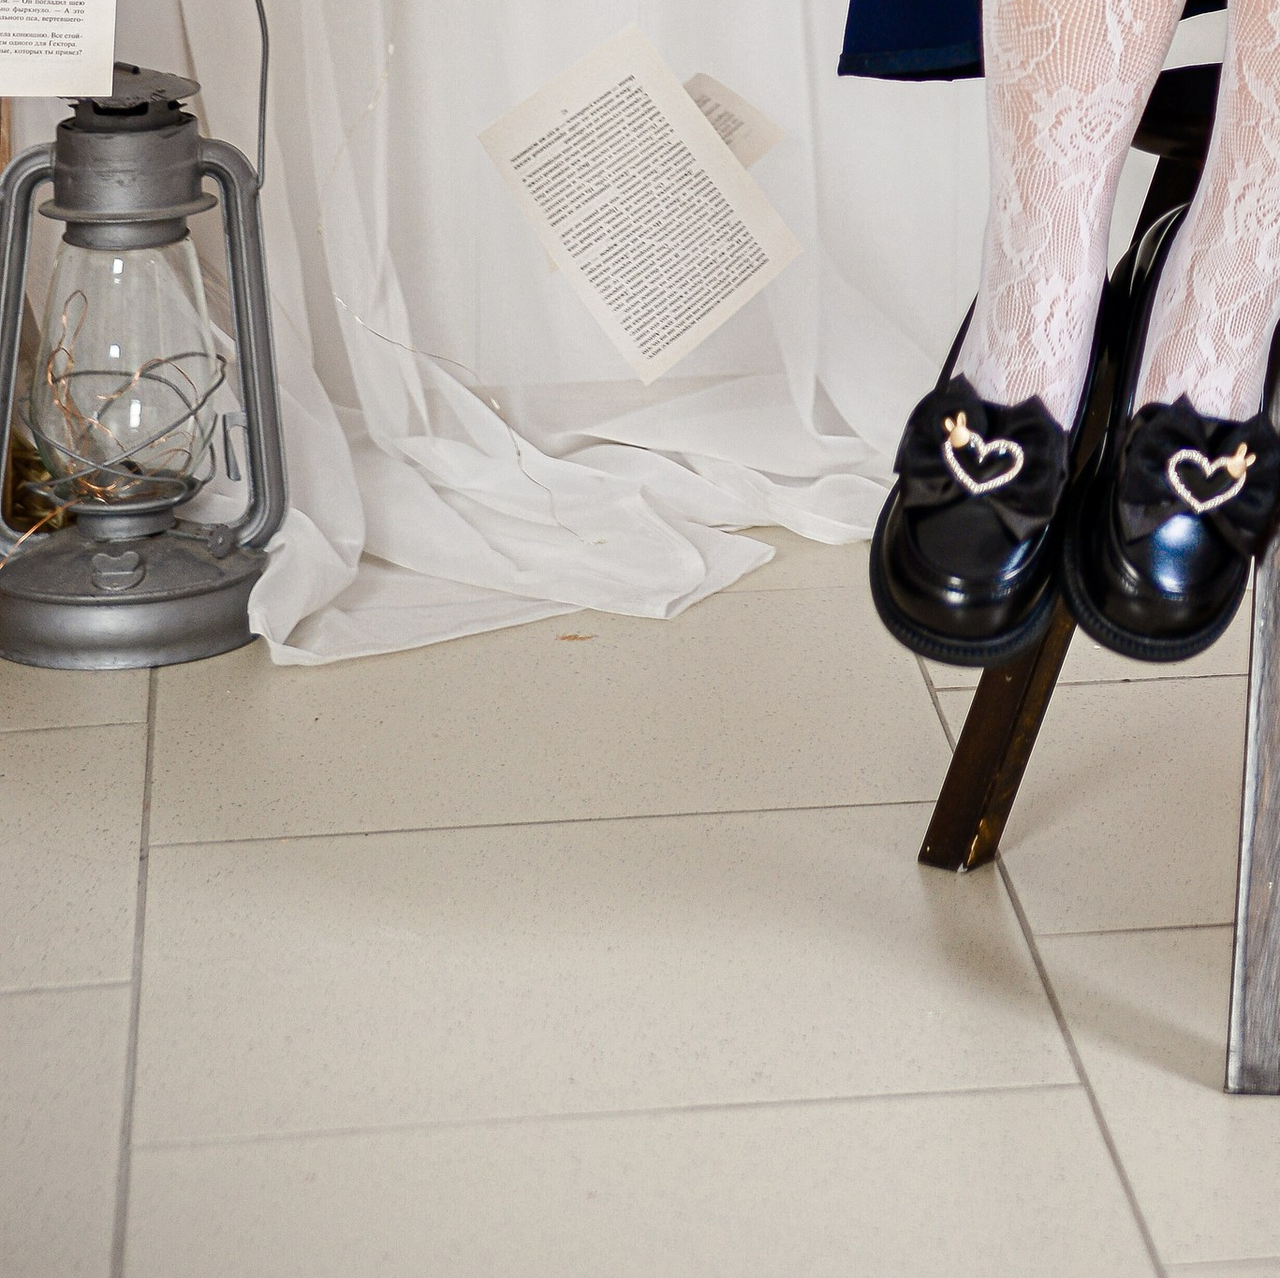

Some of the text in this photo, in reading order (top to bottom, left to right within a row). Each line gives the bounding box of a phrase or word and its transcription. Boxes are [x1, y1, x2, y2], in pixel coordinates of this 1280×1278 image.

[70, 8, 85, 16] это
[41, 16, 84, 24] вертевшего-
[50, 31, 63, 41] Все
[7, 40, 33, 48] одного
[33, 40, 47, 48] для
[13, 48, 43, 56] которых
